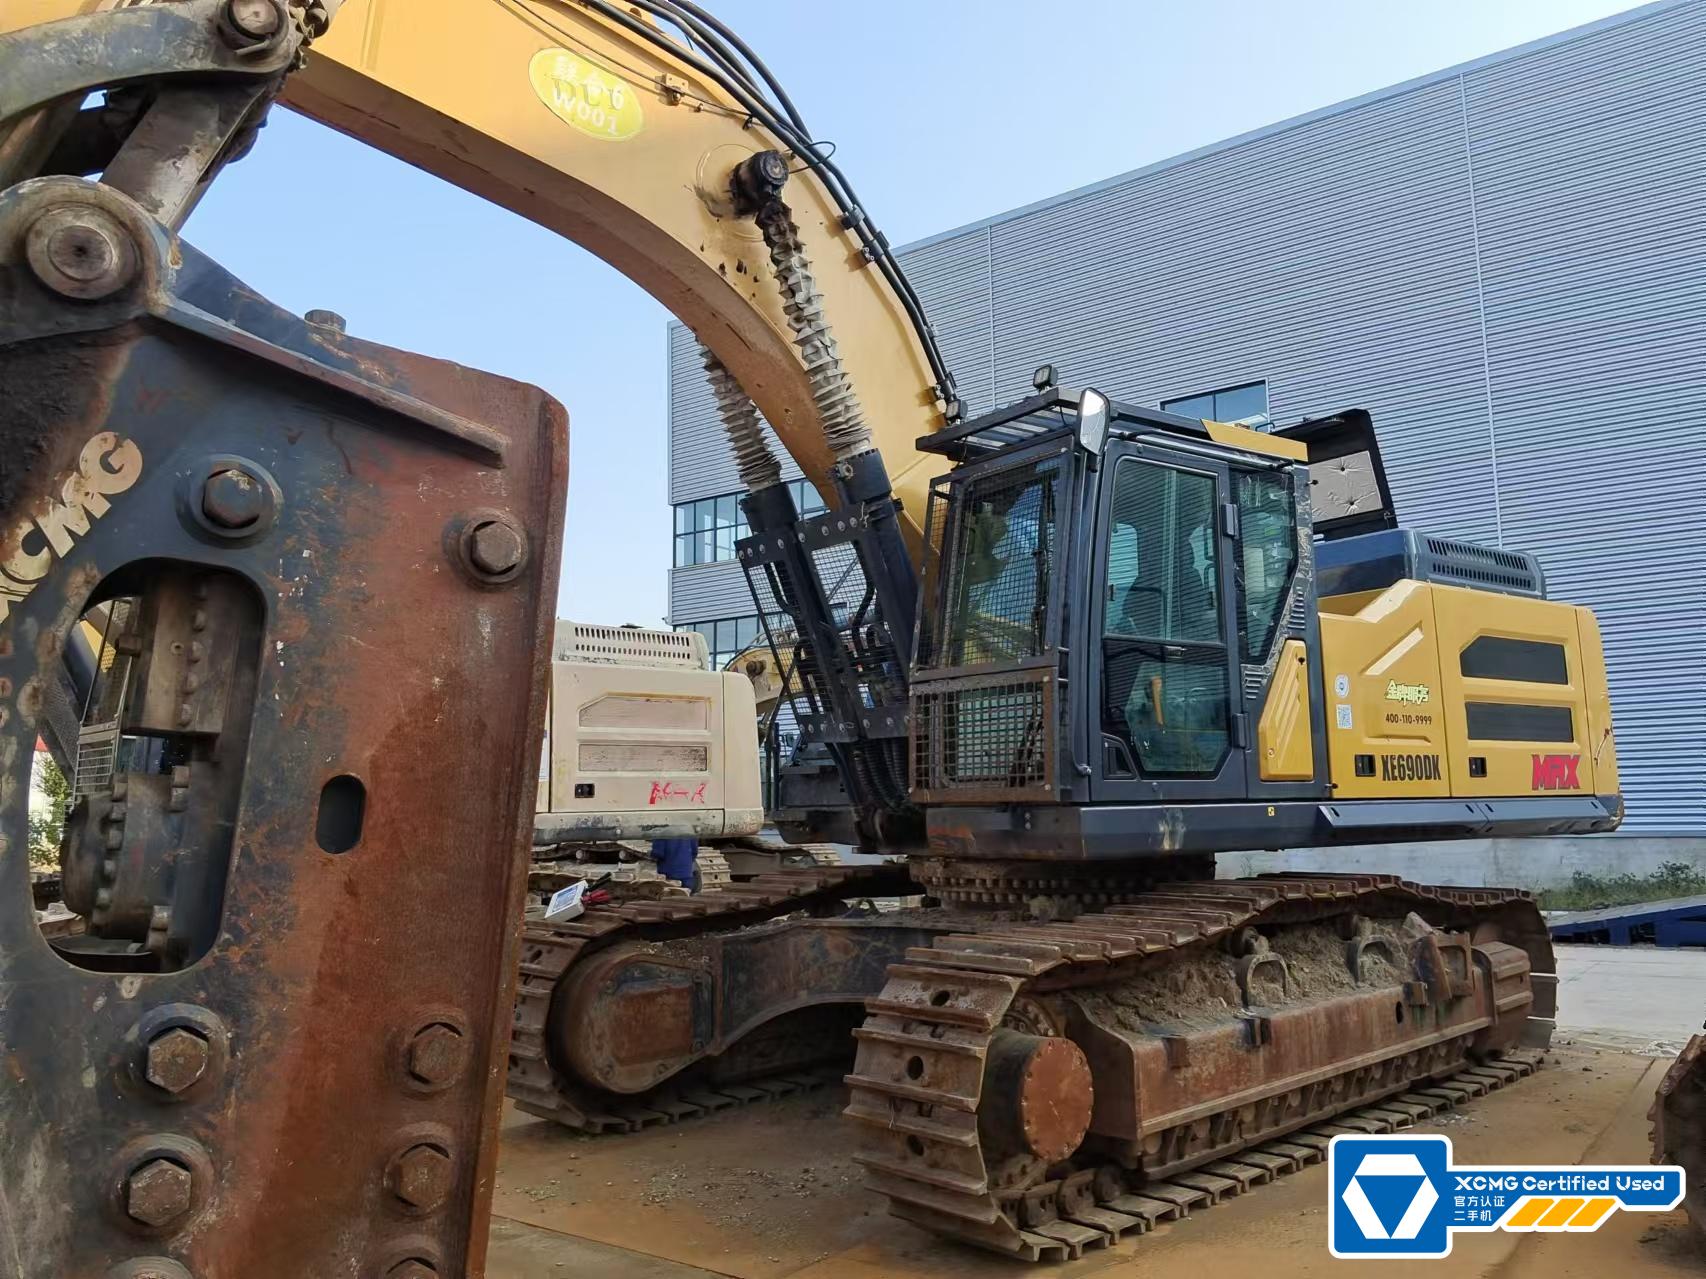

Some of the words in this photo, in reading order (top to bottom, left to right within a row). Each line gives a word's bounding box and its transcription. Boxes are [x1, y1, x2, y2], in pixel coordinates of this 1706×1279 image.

[1385, 713, 1432, 725] 400-110-9999
[1381, 754, 1441, 781] XE690DK
[1531, 754, 1581, 790] MAX
